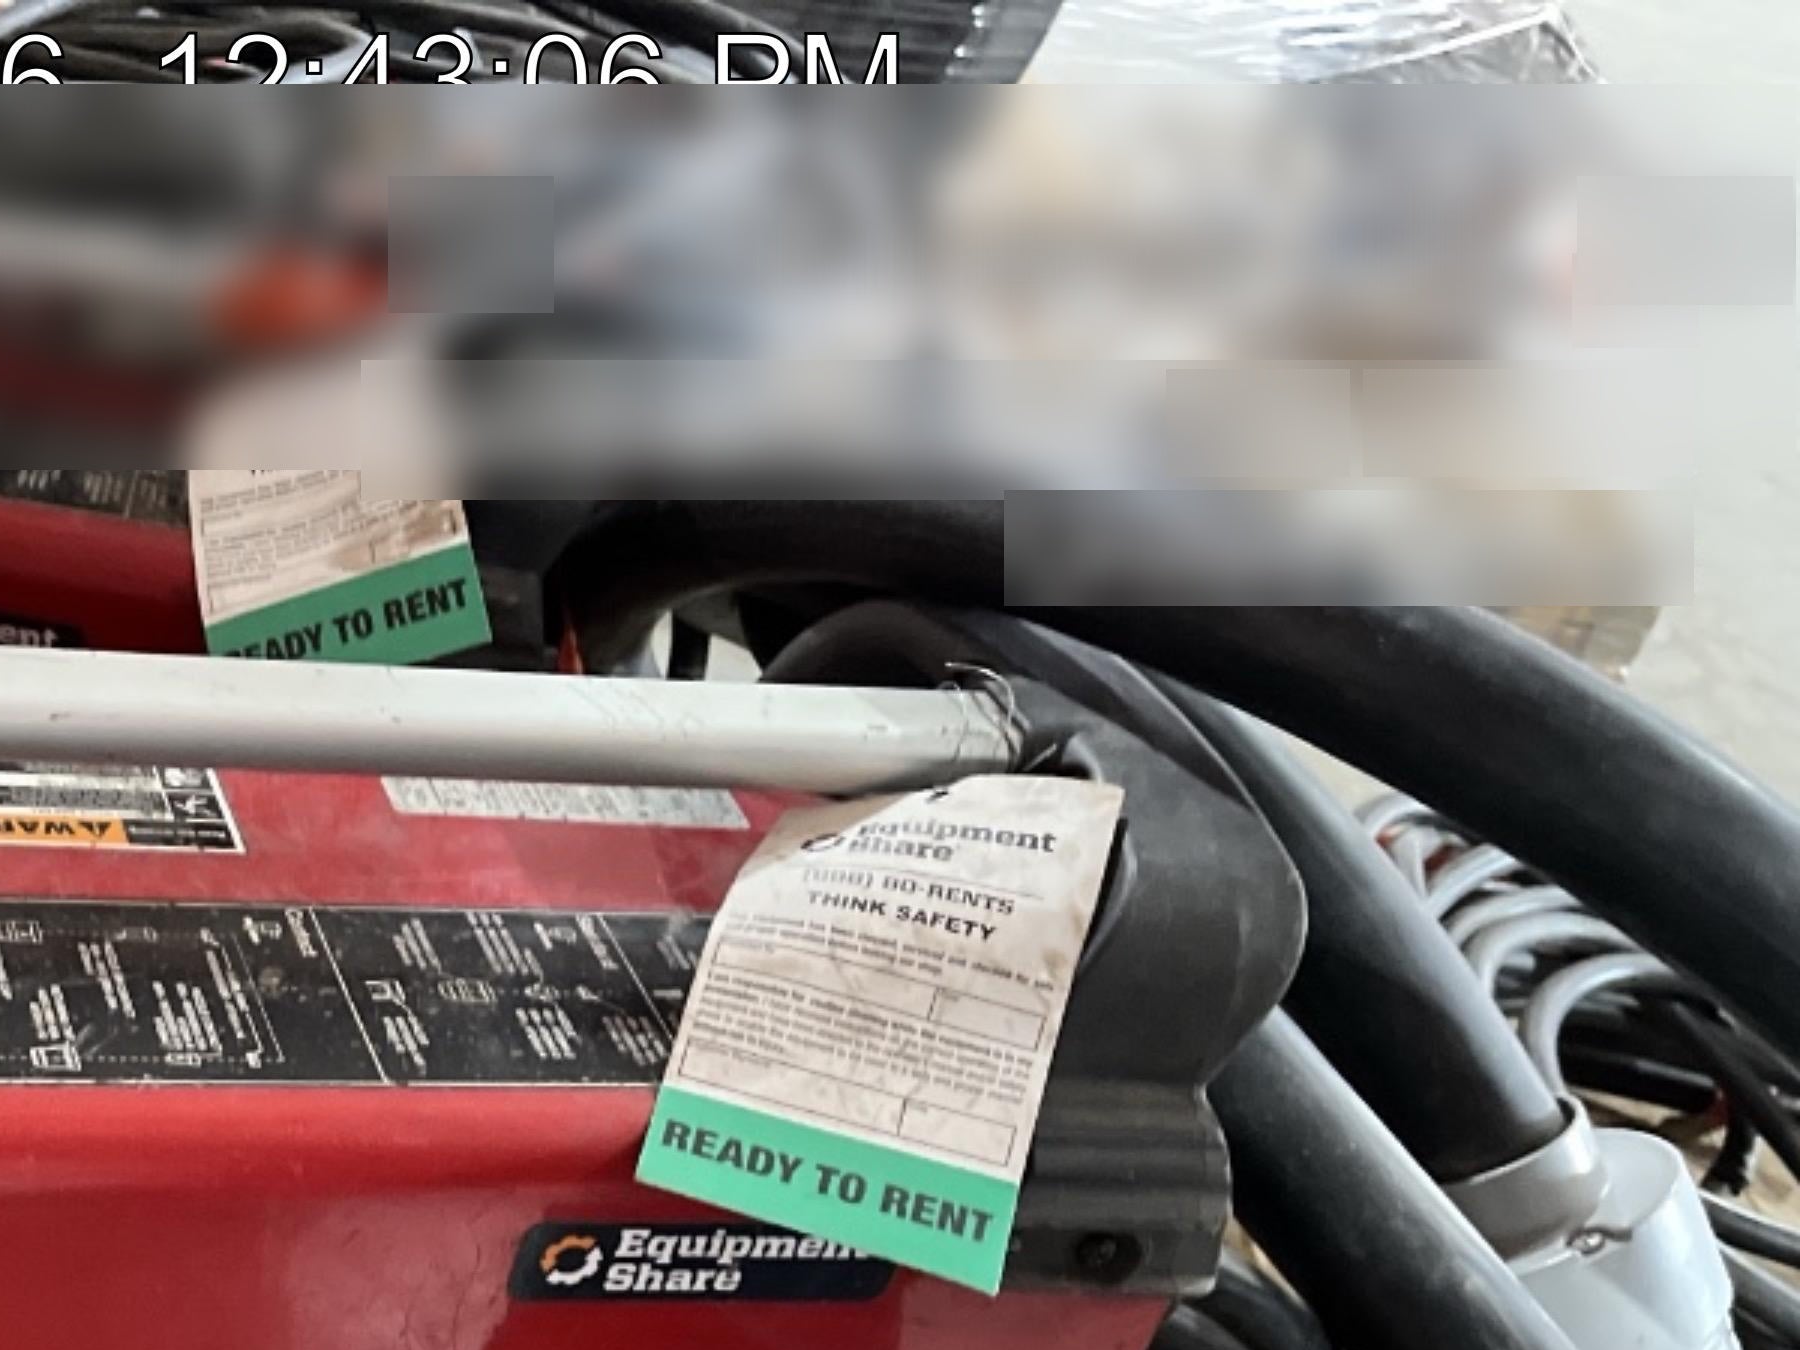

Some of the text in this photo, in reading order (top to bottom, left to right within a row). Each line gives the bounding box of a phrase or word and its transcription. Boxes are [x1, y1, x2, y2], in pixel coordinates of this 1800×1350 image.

[223, 578, 467, 659] EADY TO RENT
[807, 890, 997, 942] THINK SAFETY
[660, 1117, 997, 1244] READY TO RENT
[614, 1228, 869, 1265] Equipmen
[604, 1262, 742, 1292] Share
